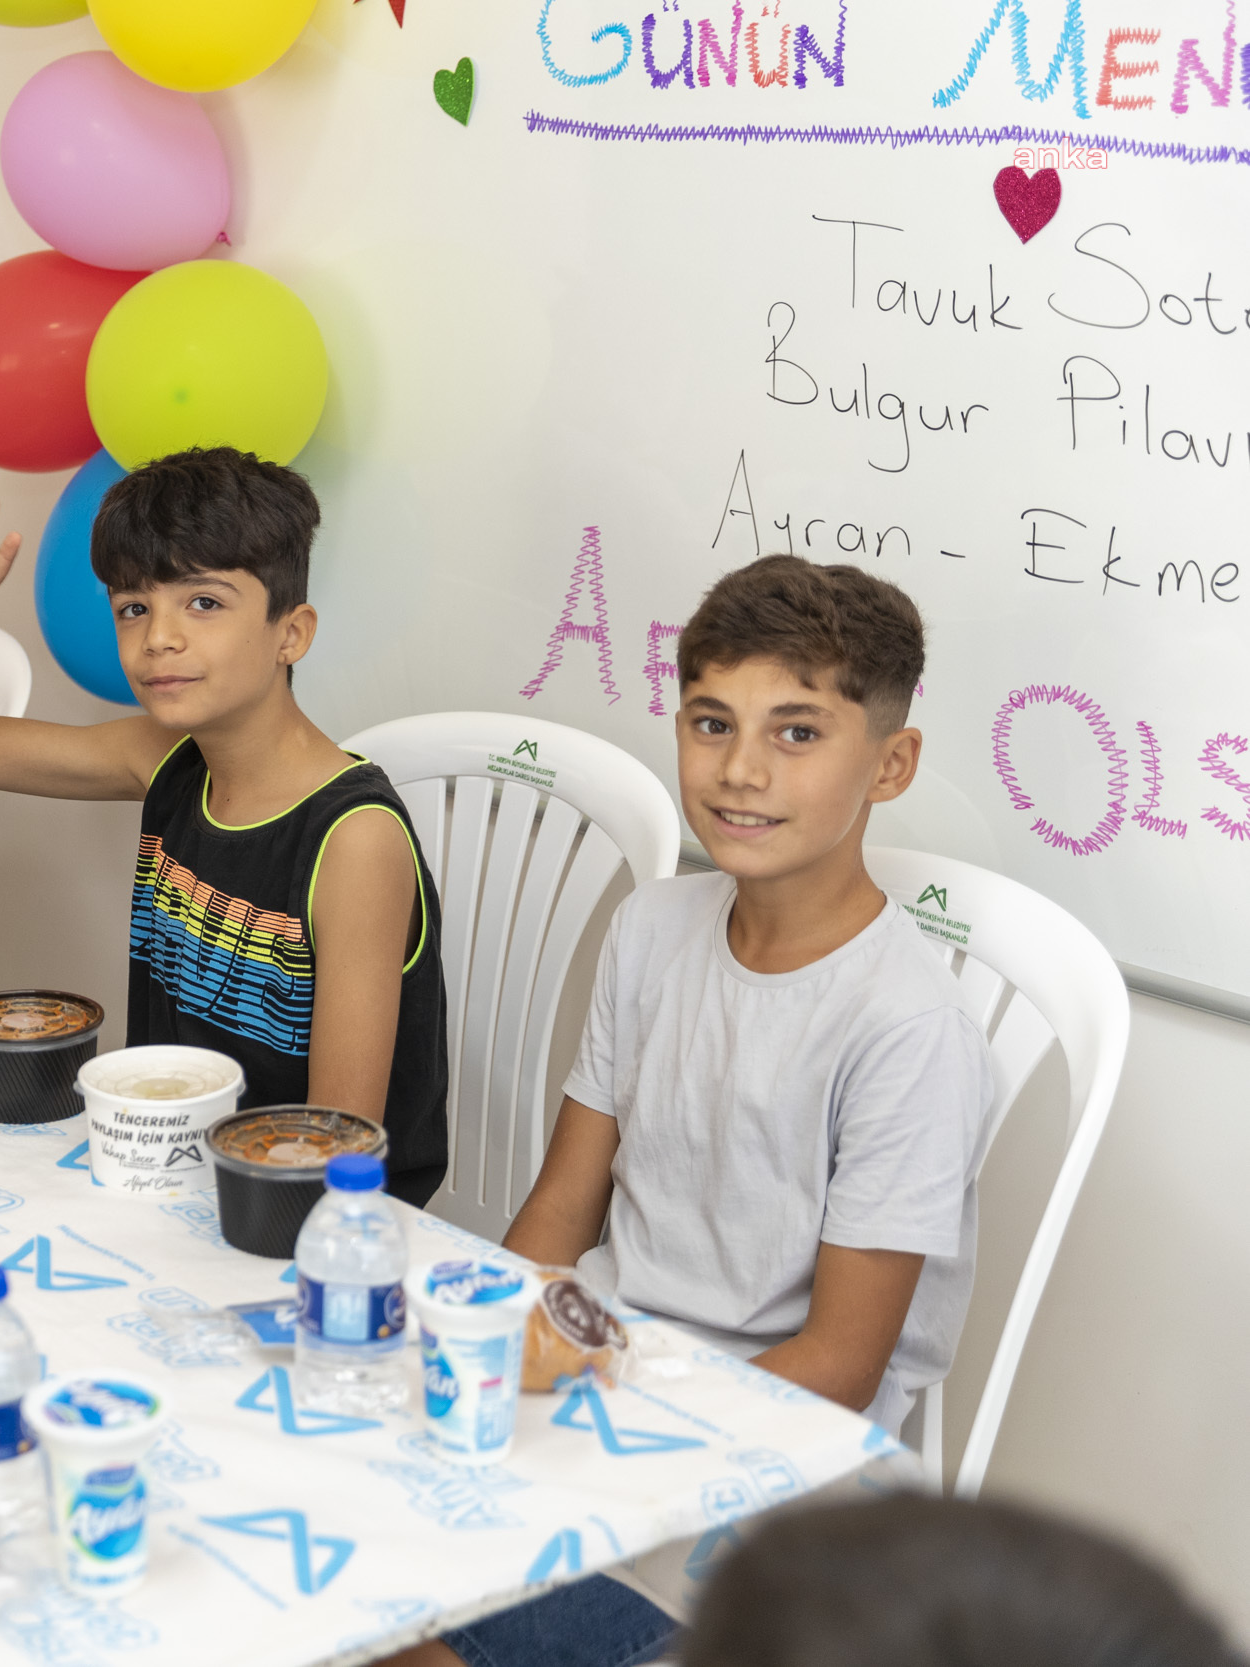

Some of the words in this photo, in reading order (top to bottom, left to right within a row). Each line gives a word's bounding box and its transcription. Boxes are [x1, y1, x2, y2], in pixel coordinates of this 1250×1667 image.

[538, 0, 847, 89] GÜNÜN
[931, 0, 1250, 119] MEN
[812, 214, 1023, 332] Tavuk
[1047, 222, 1250, 335] Sot
[764, 302, 990, 473] Bulgur
[712, 449, 910, 557] Ayran
[915, 908, 945, 925] BÜYÜKŞEHİR
[945, 918, 971, 933] BELEDİYESİ
[920, 922, 939, 935] DAİRESİ
[939, 929, 968, 945] BAŞKANLIĞI
[91, 1118, 133, 1142] PAYLAŞIM
[137, 1129, 163, 1146] İÇİN
[113, 1111, 190, 1128] TENCEREMİZ
